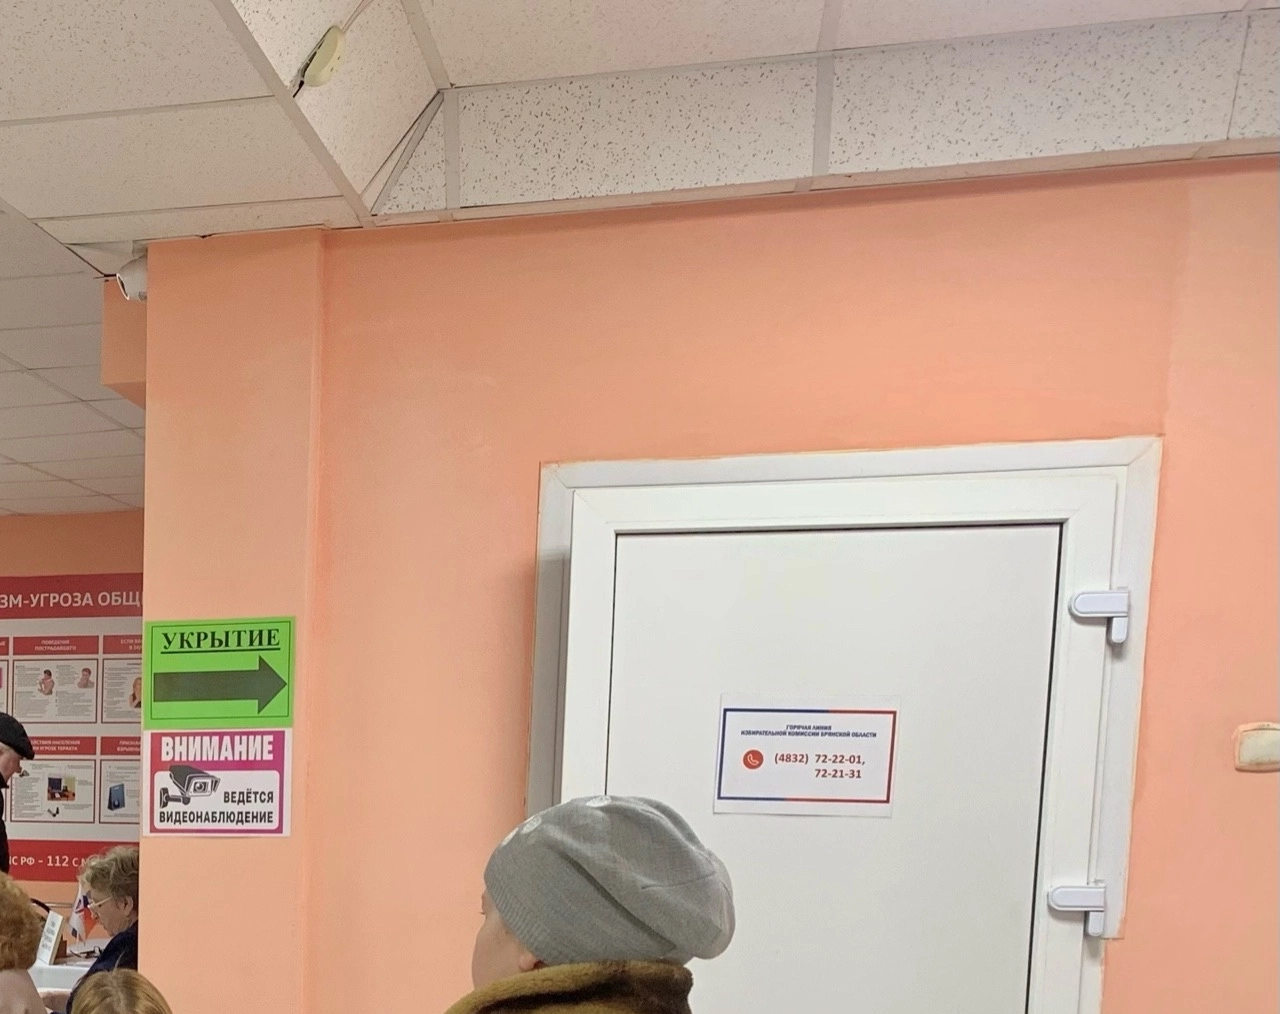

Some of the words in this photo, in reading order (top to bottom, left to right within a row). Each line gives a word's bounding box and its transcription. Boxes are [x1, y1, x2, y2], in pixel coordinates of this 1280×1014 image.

[98, 591, 142, 607] ОБЩ
[162, 628, 280, 650] УКРЫТИЕ
[741, 729, 787, 737] ИЗБИРАТЕЛЬНОЙ
[820, 730, 851, 738] БРЯНСКОЙ
[161, 735, 274, 762] ВНИМАНИЕ
[774, 753, 809, 765] (4832)
[815, 754, 866, 766] 72-22-01,
[815, 768, 862, 779] 72-21-31
[223, 789, 274, 805] ВЕДЁТСЯ
[159, 811, 274, 825] ВИДЕОНАБЛЮДЕНИЕ
[20, 856, 35, 866] РФ
[47, 855, 69, 867] 112
